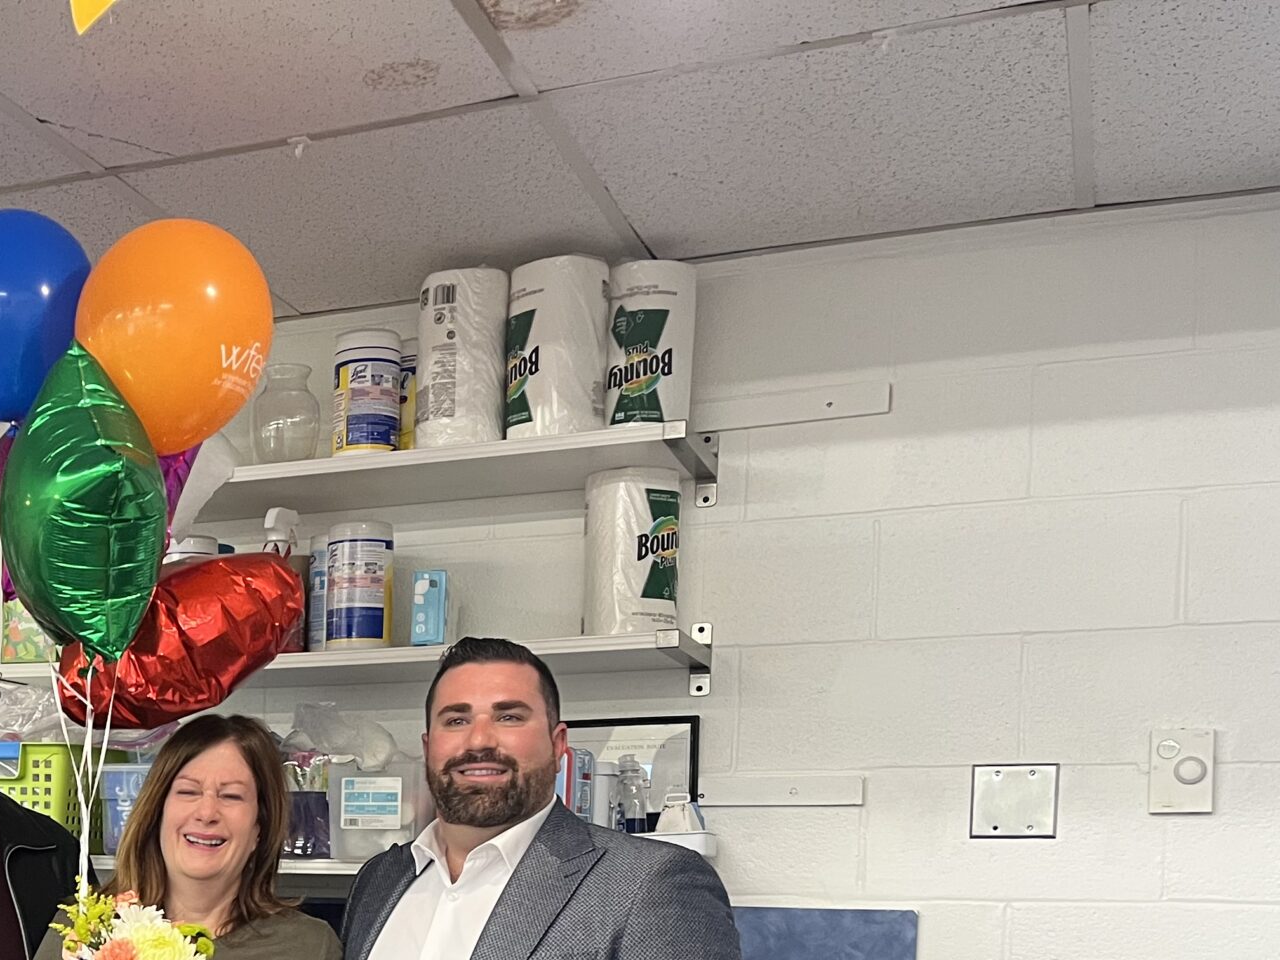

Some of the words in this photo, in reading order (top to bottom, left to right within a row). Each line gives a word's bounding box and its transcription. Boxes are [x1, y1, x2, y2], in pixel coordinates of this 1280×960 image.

[507, 345, 540, 386] Bou
[607, 347, 674, 395] Bounty
[636, 530, 680, 562] Boun
